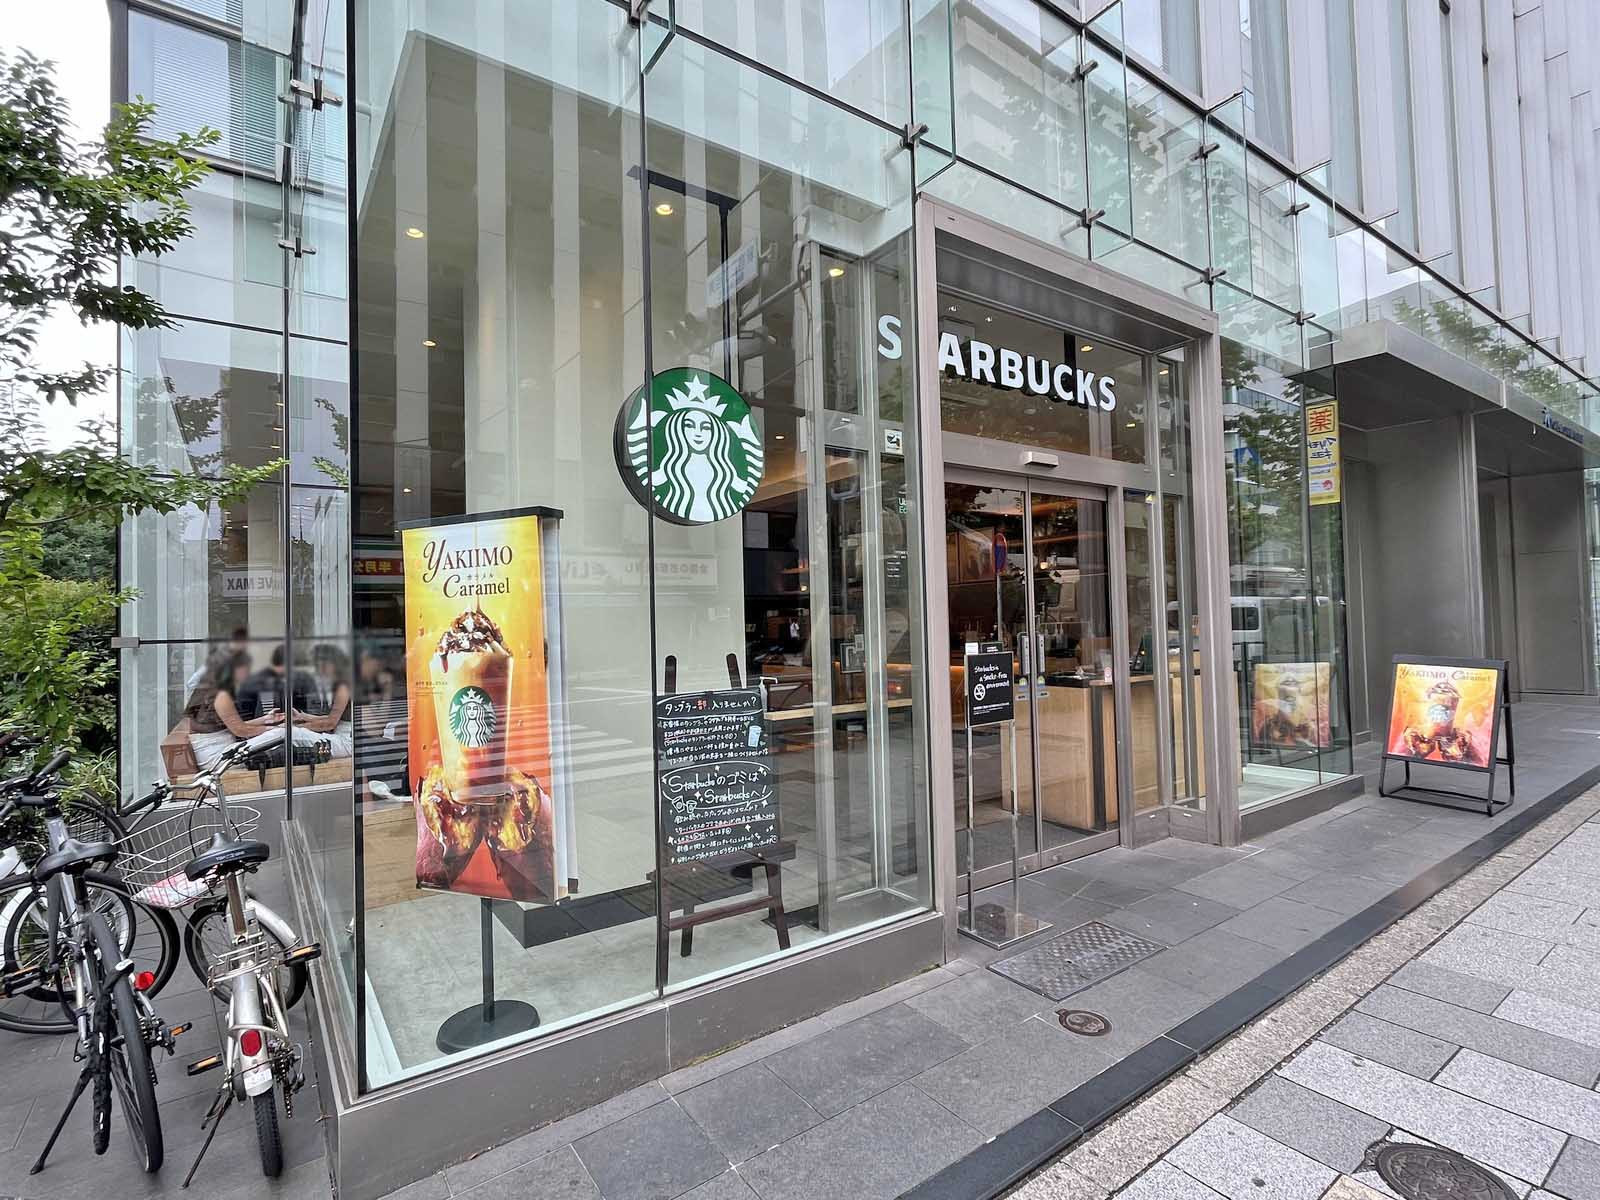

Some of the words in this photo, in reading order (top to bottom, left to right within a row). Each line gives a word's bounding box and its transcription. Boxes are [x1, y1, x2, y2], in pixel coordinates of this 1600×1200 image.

[878, 314, 1116, 412] SARBUCKS
[422, 539, 513, 583] YAKIIMO
[443, 574, 511, 598] Caramel
